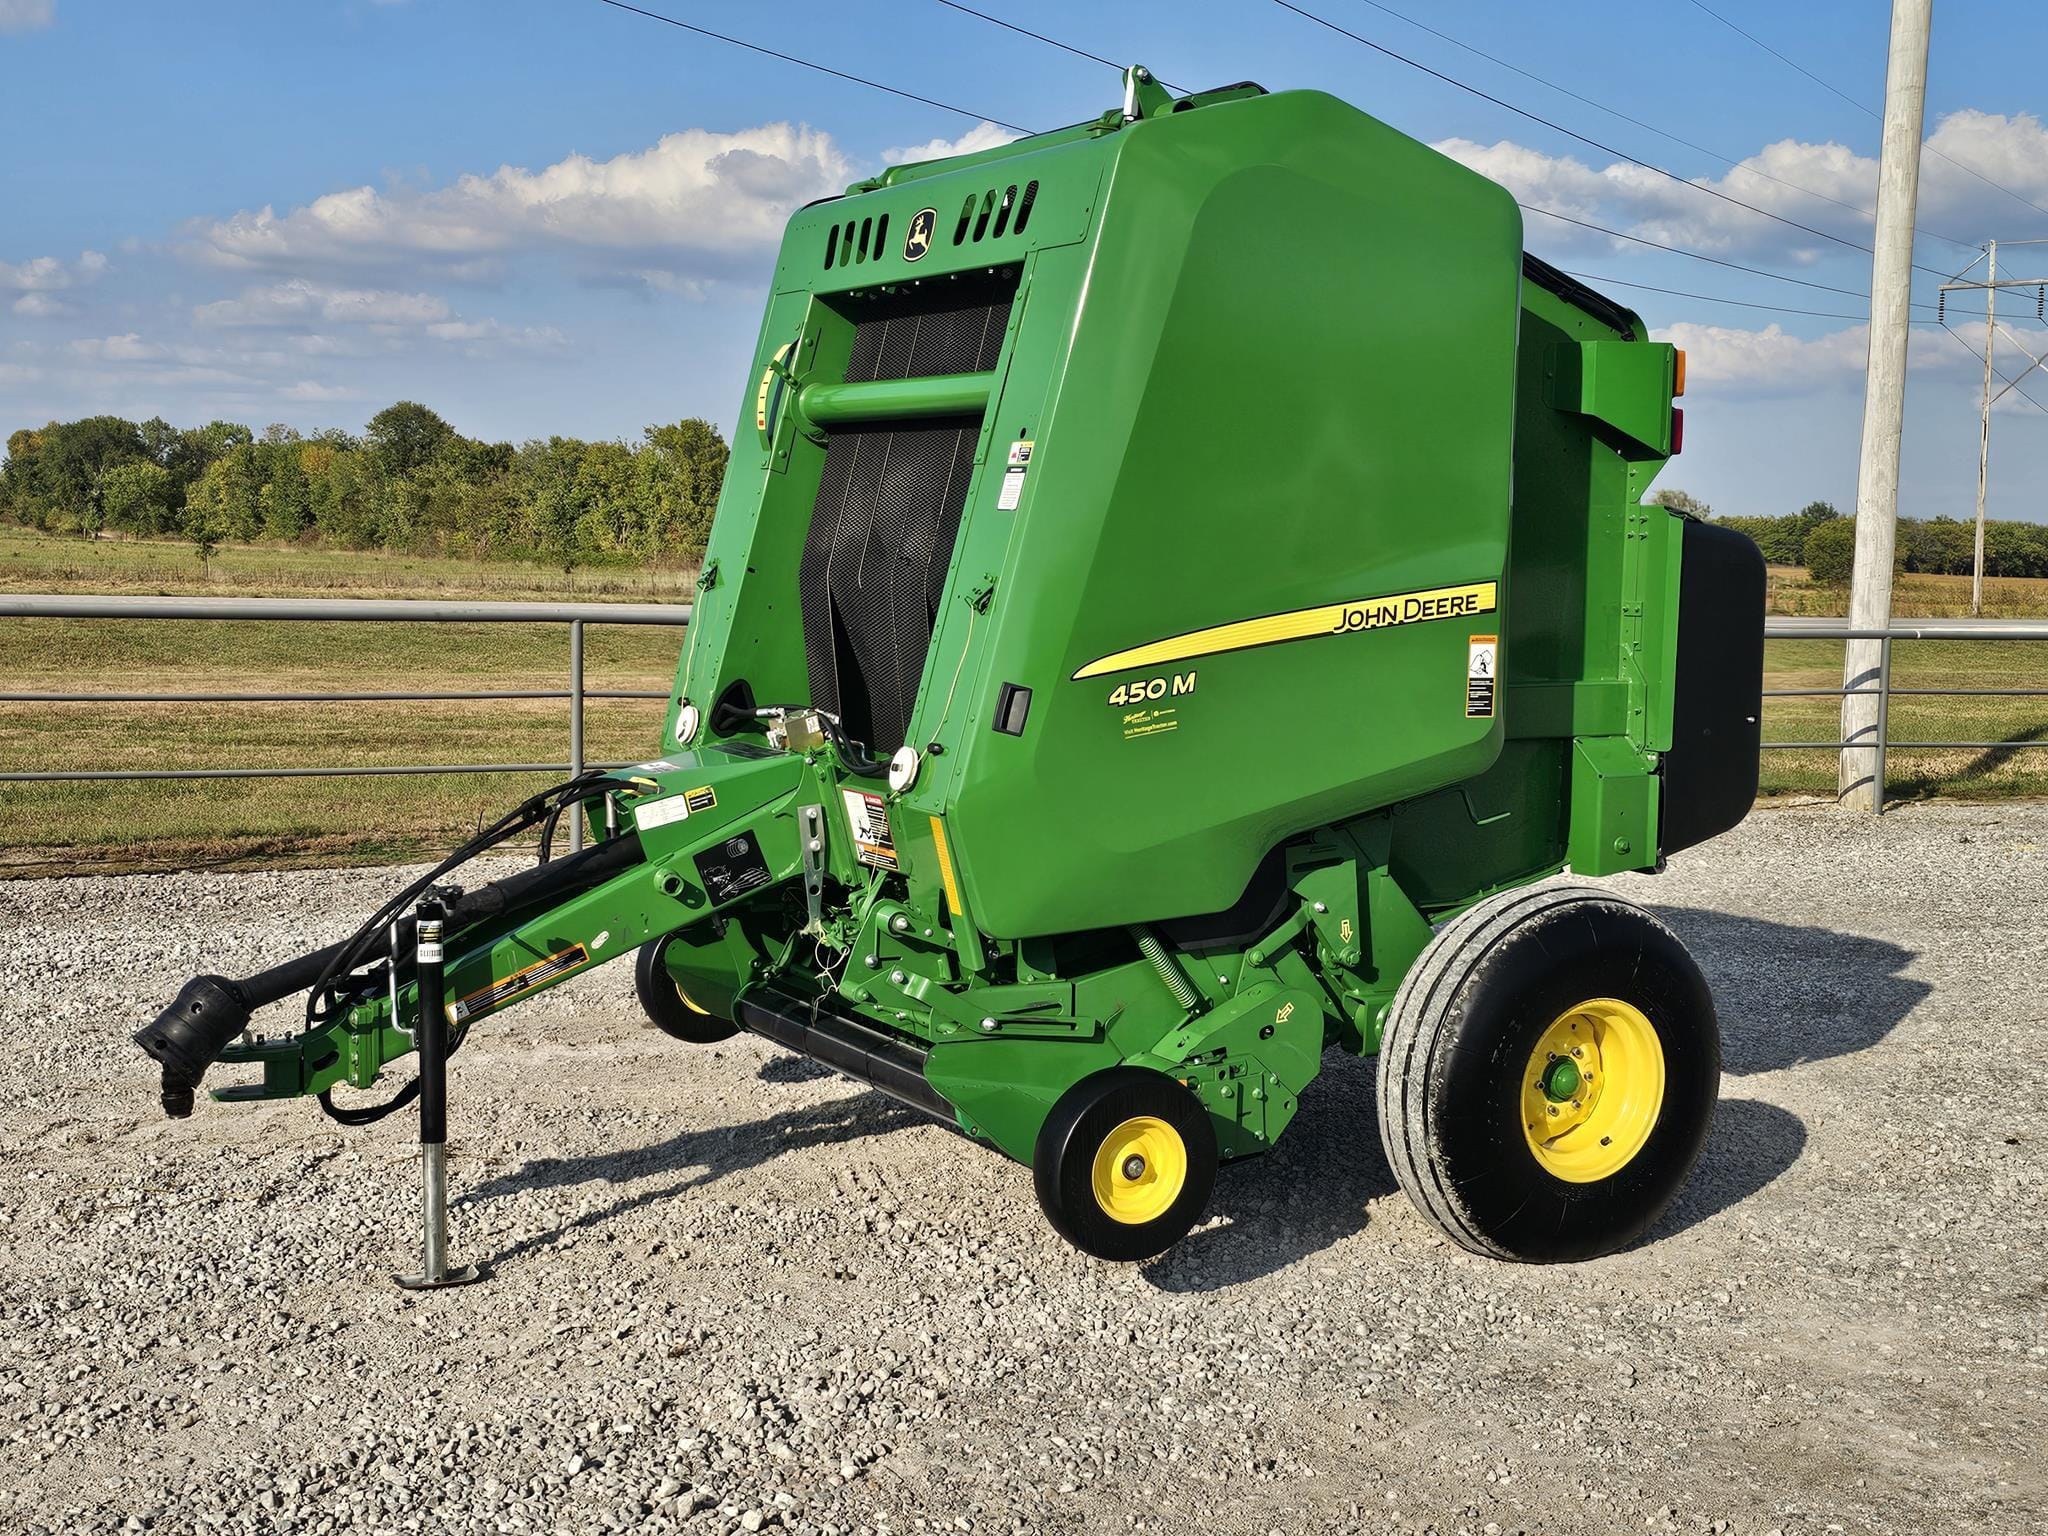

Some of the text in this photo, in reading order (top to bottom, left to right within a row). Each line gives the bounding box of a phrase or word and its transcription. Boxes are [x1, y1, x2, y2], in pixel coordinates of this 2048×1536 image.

[1333, 594, 1479, 631] JOHN DEERE
[1108, 671, 1197, 706] 450 M
